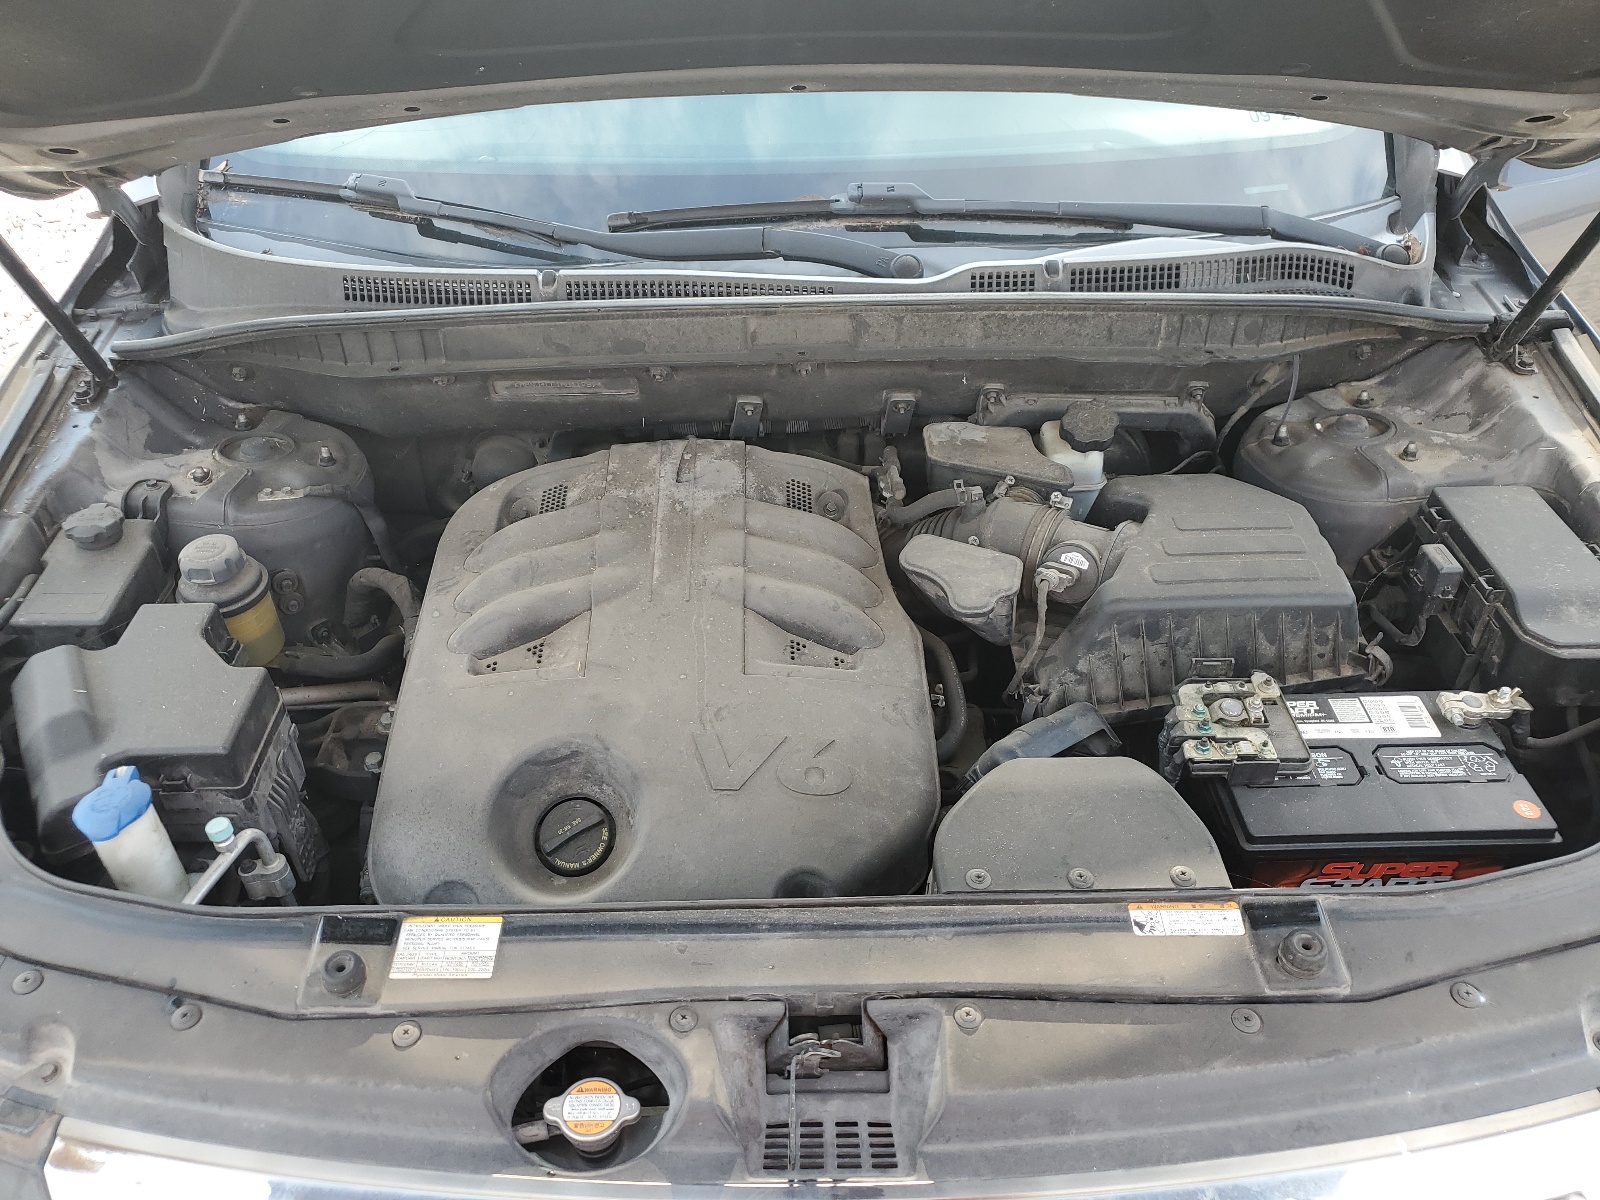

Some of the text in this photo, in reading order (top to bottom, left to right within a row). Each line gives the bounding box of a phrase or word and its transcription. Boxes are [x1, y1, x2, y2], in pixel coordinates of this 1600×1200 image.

[692, 733, 853, 796] V6
[554, 827, 609, 869] SEE OWNER'S MANUAL
[1317, 861, 1459, 880] SUPER
